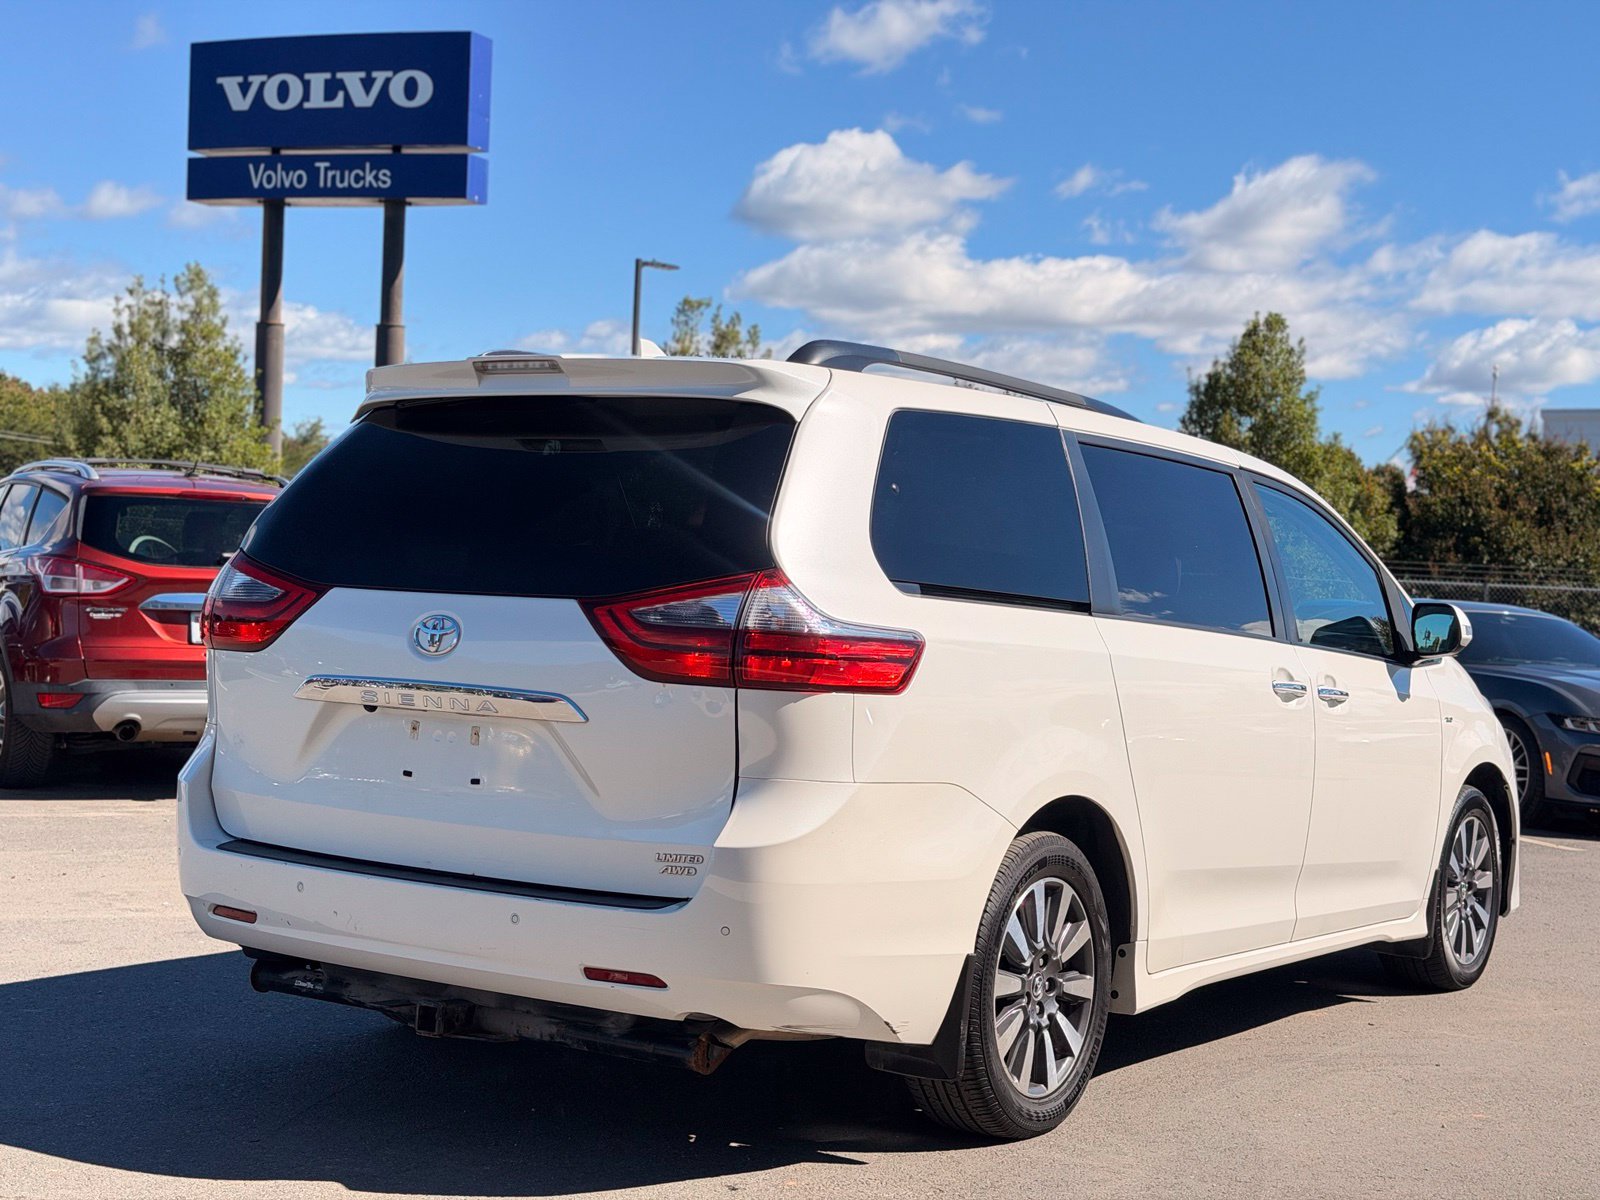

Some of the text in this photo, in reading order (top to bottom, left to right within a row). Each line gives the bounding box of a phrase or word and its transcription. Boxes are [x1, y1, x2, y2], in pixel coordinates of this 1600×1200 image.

[216, 69, 434, 111] VOLVO
[248, 162, 392, 189] Volvo Trucks
[360, 689, 499, 713] SIENNA
[655, 852, 705, 864] LIMITED
[659, 865, 698, 876] AWD
